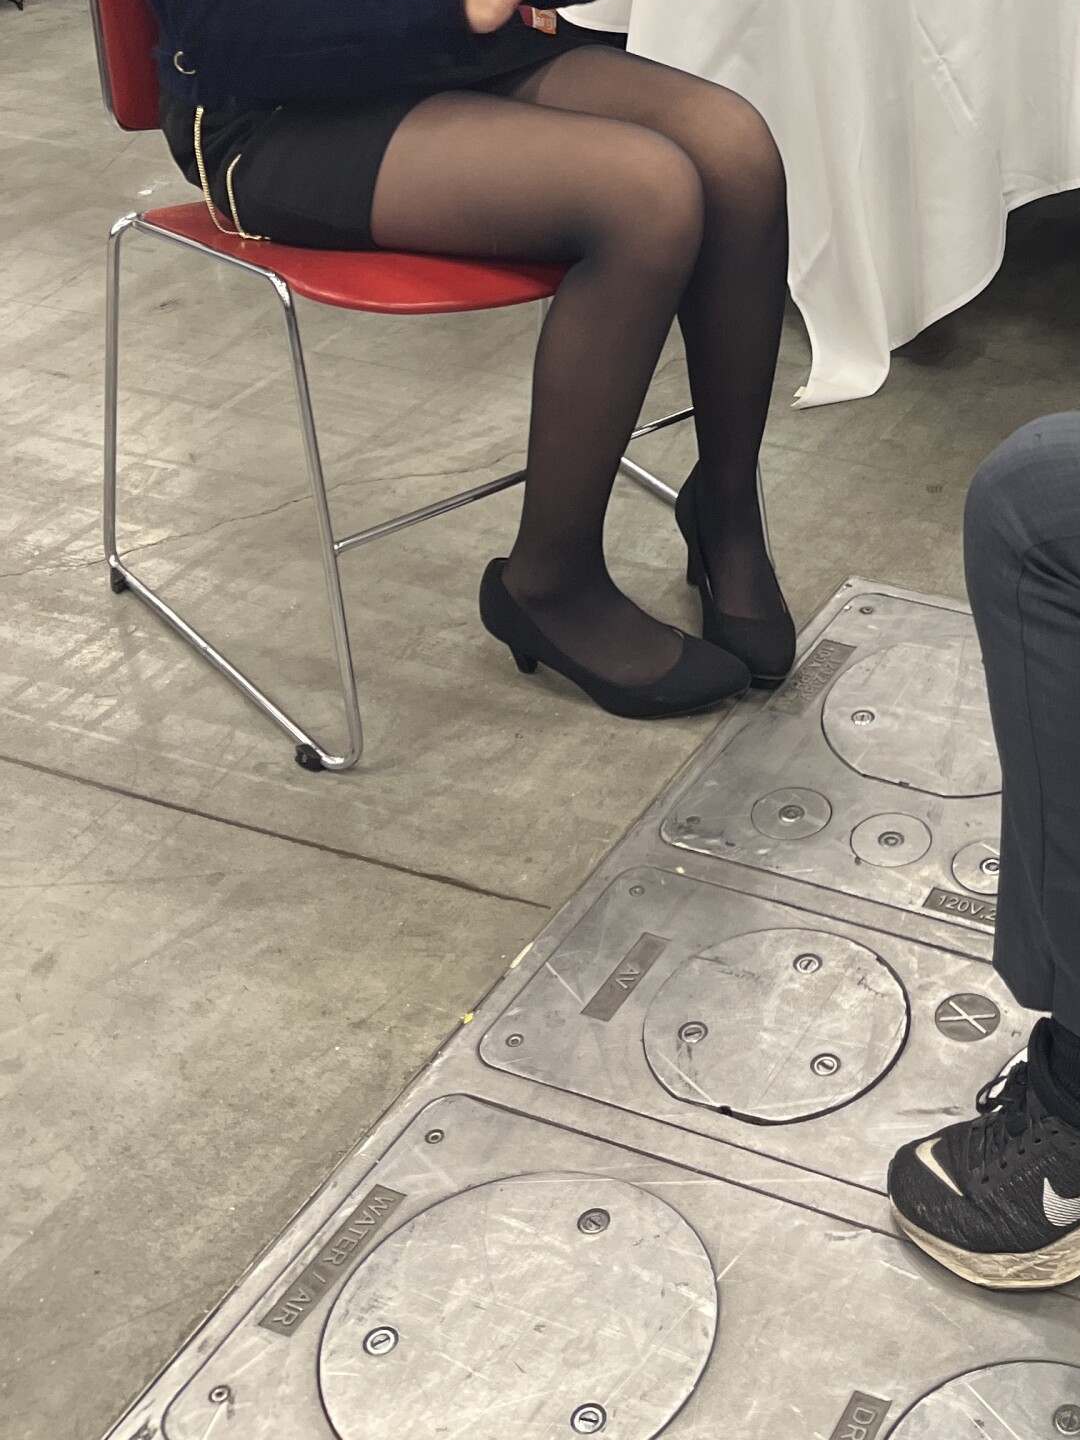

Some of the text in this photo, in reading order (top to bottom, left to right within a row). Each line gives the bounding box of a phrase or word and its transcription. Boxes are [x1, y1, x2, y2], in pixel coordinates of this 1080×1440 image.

[615, 964, 640, 990] AV
[323, 1195, 395, 1266] WATER
[273, 1288, 312, 1327] AIR
[840, 1406, 877, 1440] DR
